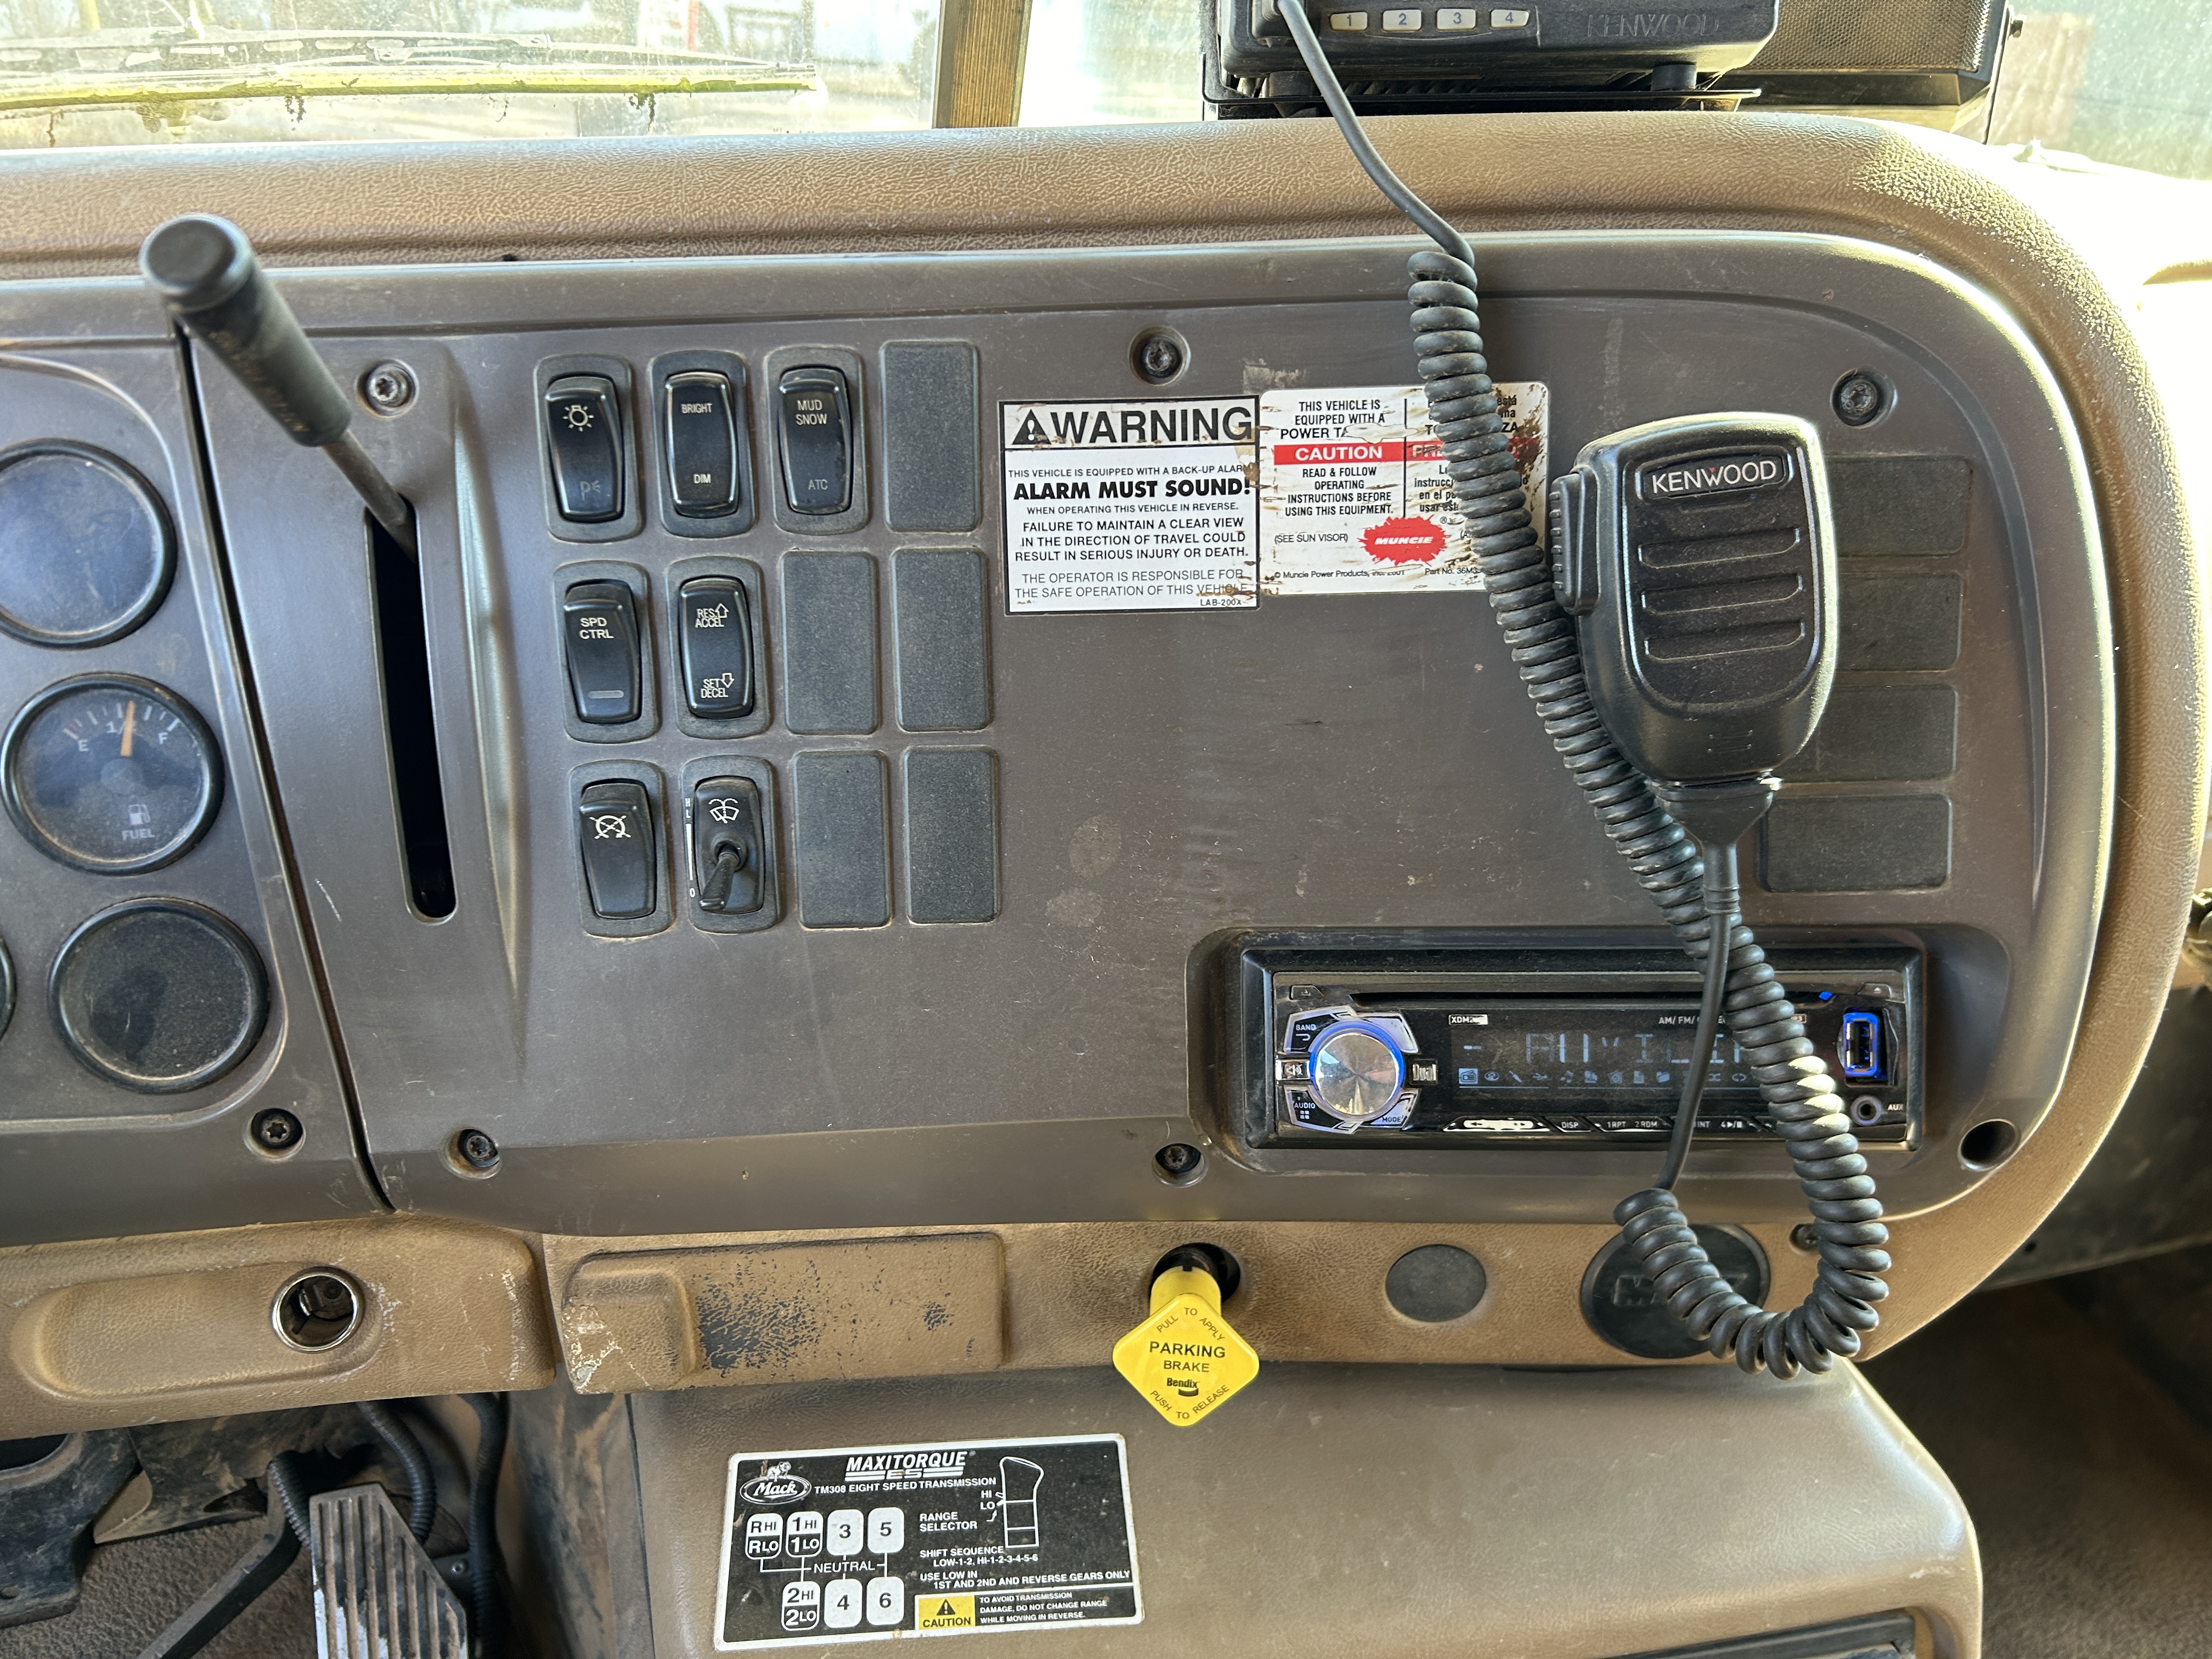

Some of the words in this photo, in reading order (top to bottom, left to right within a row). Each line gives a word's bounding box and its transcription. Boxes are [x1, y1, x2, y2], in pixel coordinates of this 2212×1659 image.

[1347, 14, 1352, 26] 1
[1398, 13, 1407, 26] 2
[1454, 12, 1462, 24] 3
[1505, 12, 1514, 24] 4
[1588, 13, 1719, 37] KENWOOD
[681, 403, 713, 414] BRIGHT
[797, 400, 823, 412] MUD
[1299, 401, 1322, 411] THIS
[1325, 400, 1367, 410] VEHICLE
[1371, 399, 1380, 409] IS
[795, 413, 827, 426] SNOW
[1295, 414, 1344, 425] EQUIPPED
[1348, 413, 1374, 424] WITH
[1378, 413, 1385, 423] A
[1051, 407, 1252, 444] WARNING
[1280, 427, 1329, 439] POWER
[1295, 446, 1383, 461] CAUTION
[1032, 469, 1071, 477] VEHICLE
[1086, 468, 1133, 476] EQUIPPED
[1163, 466, 1169, 475] A
[1172, 466, 1215, 474] BACK-UP
[1302, 469, 1326, 477] READ
[1339, 467, 1377, 476] FOLLOW
[1652, 460, 1776, 494] KENWOOD
[693, 473, 712, 484] DIM
[808, 479, 828, 490] ATC
[1013, 482, 1090, 500] ALARM
[1098, 481, 1158, 498] MUST
[1165, 476, 1250, 497] SOUND!
[1314, 480, 1364, 490] OPERATING
[1288, 493, 1353, 504] INSTRUCTIONS
[1357, 492, 1391, 501] BEFORE
[1419, 492, 1430, 500] en
[1434, 489, 1442, 500] el
[1058, 506, 1111, 514] OPERATING
[1114, 505, 1135, 513] THIS
[1138, 504, 1177, 512] VEHICLE
[1193, 502, 1239, 511] REVERSE.
[1285, 506, 1312, 516] USING
[1316, 506, 1336, 515] THIS
[1339, 505, 1393, 515] EQUIPMENT.
[1023, 522, 1073, 532] FAILURE
[1076, 521, 1093, 531] TO
[1097, 520, 1154, 531] MAINTAIN
[1158, 520, 1166, 529] A
[1170, 518, 1210, 529] CLEAR
[1214, 517, 1244, 527] VIEW
[1022, 537, 1033, 546] IN
[1037, 537, 1060, 546] THE
[1065, 535, 1130, 546] DIRECTION
[1135, 535, 1150, 544] OF
[1153, 534, 1199, 544] TRAVEL
[1203, 532, 1245, 543] COULD
[1274, 535, 1294, 544] (SEE
[1296, 534, 1316, 543] SUN
[1318, 533, 1348, 543] VISOR)
[1374, 537, 1434, 545] MUNCIE
[1015, 551, 1060, 561] RESULT
[1064, 551, 1076, 560] IN
[1080, 549, 1133, 560] SERIOUS
[1137, 548, 1180, 558] INJURY
[1184, 548, 1201, 557] OR
[1205, 547, 1249, 557] DEATH.
[1022, 574, 1045, 583] THE
[1049, 572, 1114, 583] OPERATOR
[1118, 572, 1128, 582] IS
[1132, 570, 1215, 581] RESPONSIBLE
[1219, 569, 1243, 579] FOR
[1015, 588, 1038, 598] THE
[1042, 587, 1072, 597] SAFE
[1076, 585, 1143, 597] OPERATION
[1147, 585, 1163, 595] OF
[1167, 584, 1193, 594] THIS
[580, 617, 607, 627] SPD
[695, 618, 725, 628] ACCEL
[579, 629, 614, 639] CTRL
[703, 679, 721, 689] SET
[701, 688, 729, 698] DECEL
[78, 739, 89, 752] E
[158, 731, 168, 744] F
[122, 828, 155, 841] FUEL
[1413, 1064, 1436, 1081] Dual
[1156, 1316, 1179, 1333] PULL
[1184, 1307, 1198, 1316] TO
[1199, 1317, 1225, 1341] APPLY
[1149, 1341, 1226, 1358] PARKING
[1163, 1360, 1210, 1373] BRAKE
[1166, 1378, 1198, 1389] Bendix
[1150, 1390, 1172, 1411] PUSH
[1176, 1411, 1189, 1419] TO
[1192, 1385, 1230, 1414] RELEASE
[846, 1451, 968, 1471] MAXITORQUE
[753, 1480, 798, 1496] Mack
[815, 1485, 846, 1494] TM308
[849, 1483, 880, 1493] EIGHT
[882, 1481, 918, 1491] SPEED
[918, 1477, 996, 1489] TRANSMISSION
[981, 1490, 992, 1498] HI
[980, 1501, 996, 1510] LO
[919, 1511, 958, 1522] RANGE
[839, 1524, 851, 1539] 3
[879, 1522, 893, 1537] 5
[919, 1521, 978, 1532] SELECTOR
[919, 1549, 948, 1558] SHIFT
[950, 1546, 1004, 1556] SEQUENCE
[977, 1554, 1039, 1565] HI-1-2-3-4-5-6
[814, 1561, 875, 1573] NEUTRAL
[919, 1572, 940, 1581] USE
[943, 1571, 965, 1580] LOW
[967, 1570, 978, 1578] IN
[934, 1581, 951, 1589] 1ST
[953, 1579, 974, 1588] AND
[977, 1578, 996, 1588] 2ND
[998, 1577, 1020, 1586] AND
[1022, 1574, 1067, 1584] REVERSE
[1070, 1571, 1104, 1582] GEARS
[1105, 1570, 1130, 1579] ONLY
[837, 1594, 850, 1610] 4
[879, 1593, 892, 1608] 6
[1015, 1592, 1073, 1601] TRANSMISSION
[1046, 1601, 1079, 1610] CHANGE
[923, 1617, 971, 1628] CAUTION
[1006, 1614, 1036, 1622] MOVING
